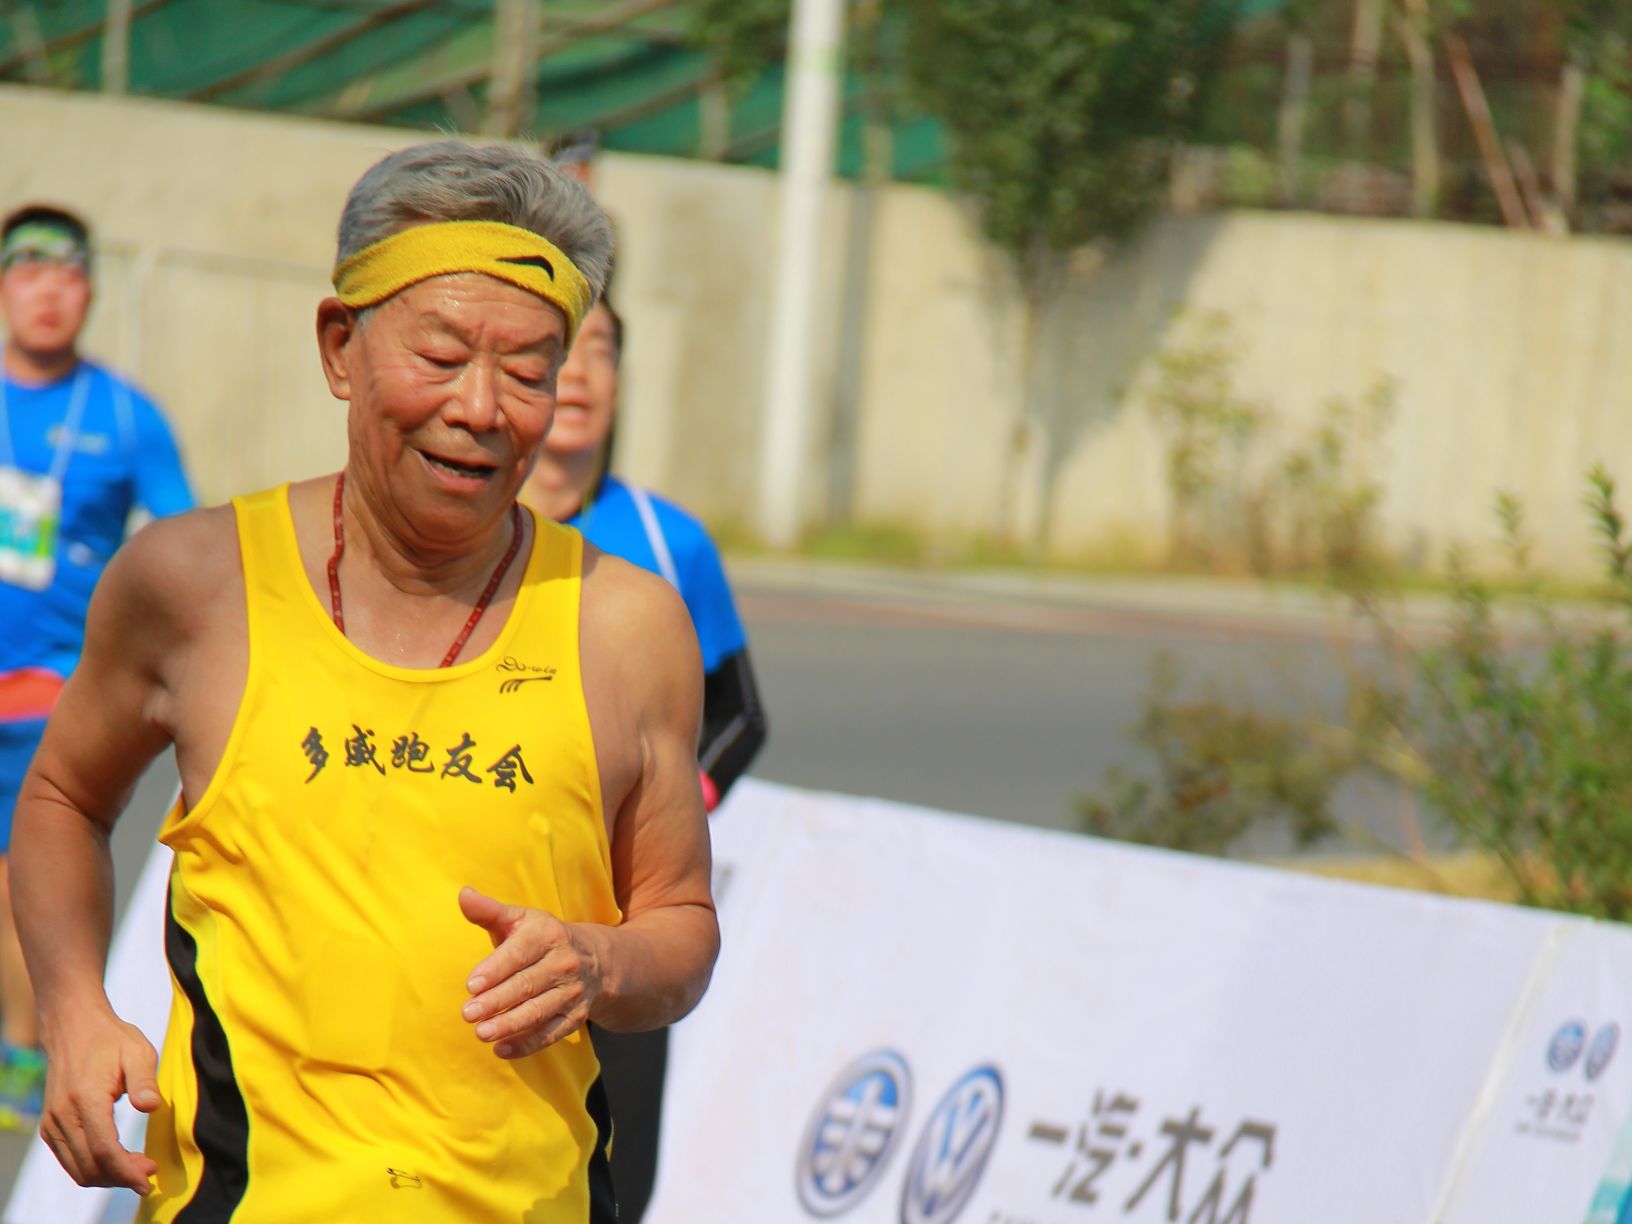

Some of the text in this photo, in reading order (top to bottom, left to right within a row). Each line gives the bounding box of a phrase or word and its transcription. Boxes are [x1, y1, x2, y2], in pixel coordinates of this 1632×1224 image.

[301, 723, 534, 793] 多威跑友会
